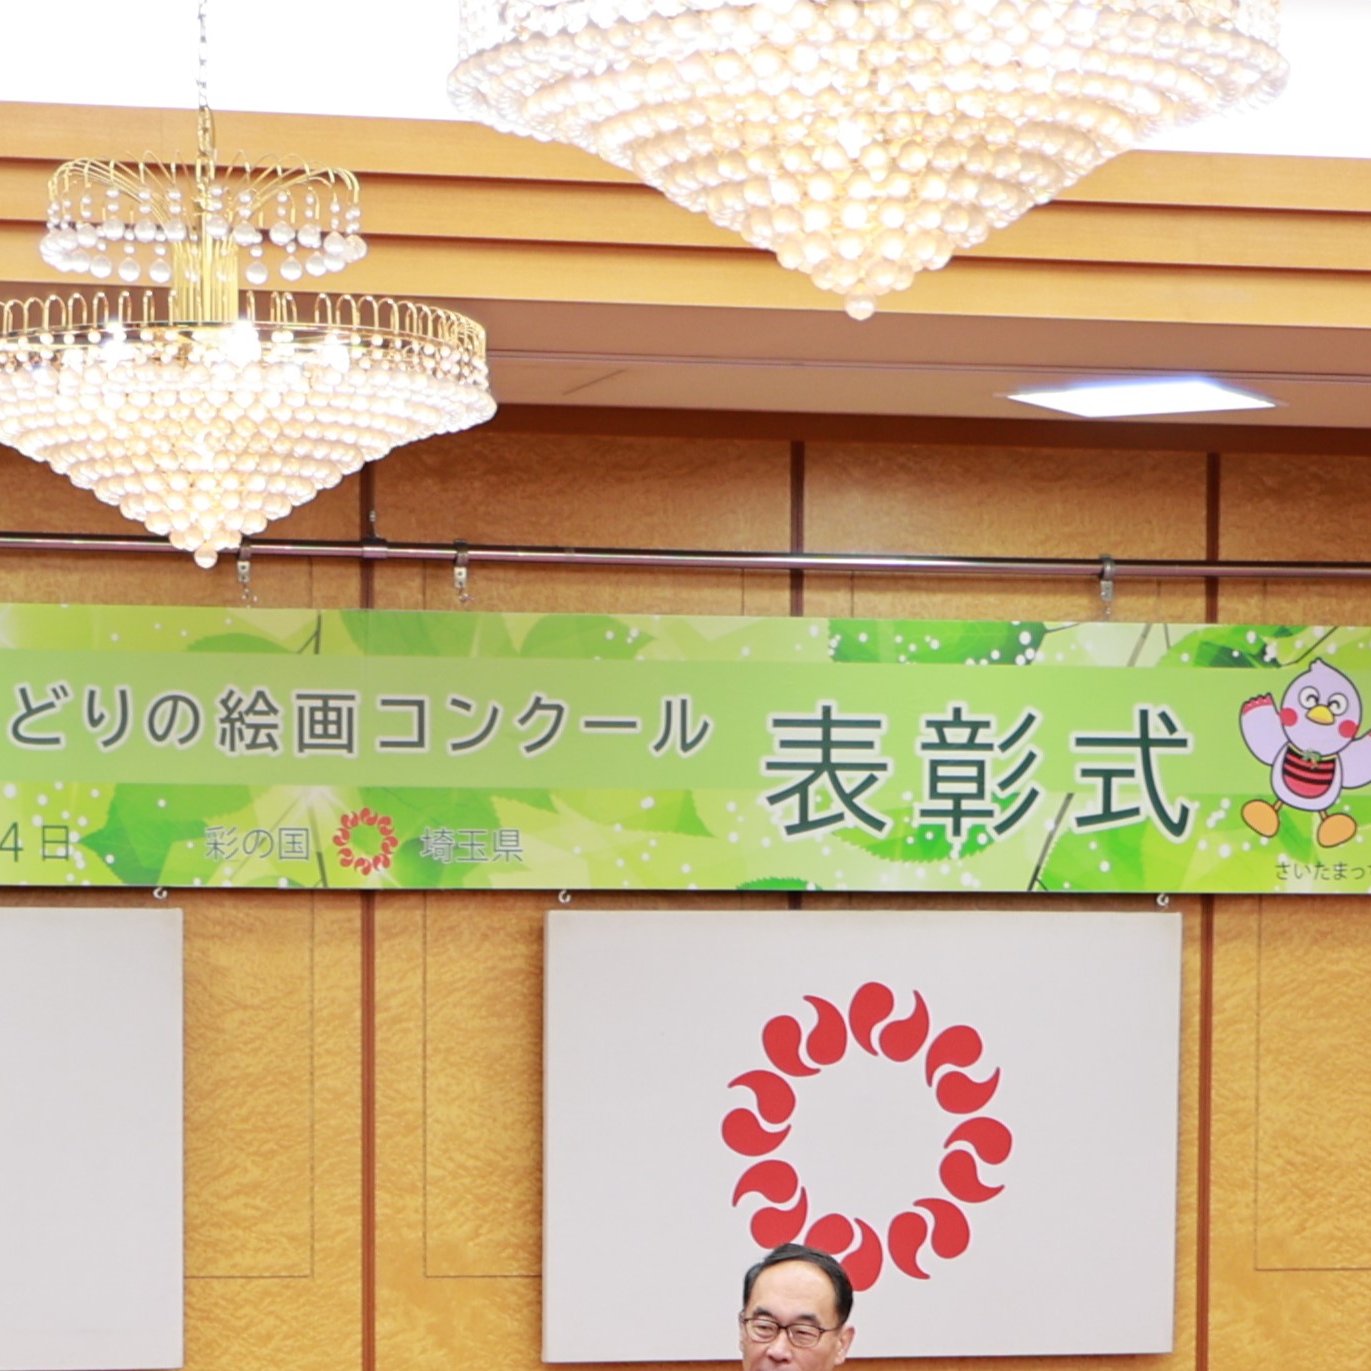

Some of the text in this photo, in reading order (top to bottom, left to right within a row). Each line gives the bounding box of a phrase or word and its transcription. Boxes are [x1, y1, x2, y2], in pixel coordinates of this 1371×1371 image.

[762, 703, 1192, 840] 表彰式
[204, 825, 524, 863] 彩の国 埼玉県
